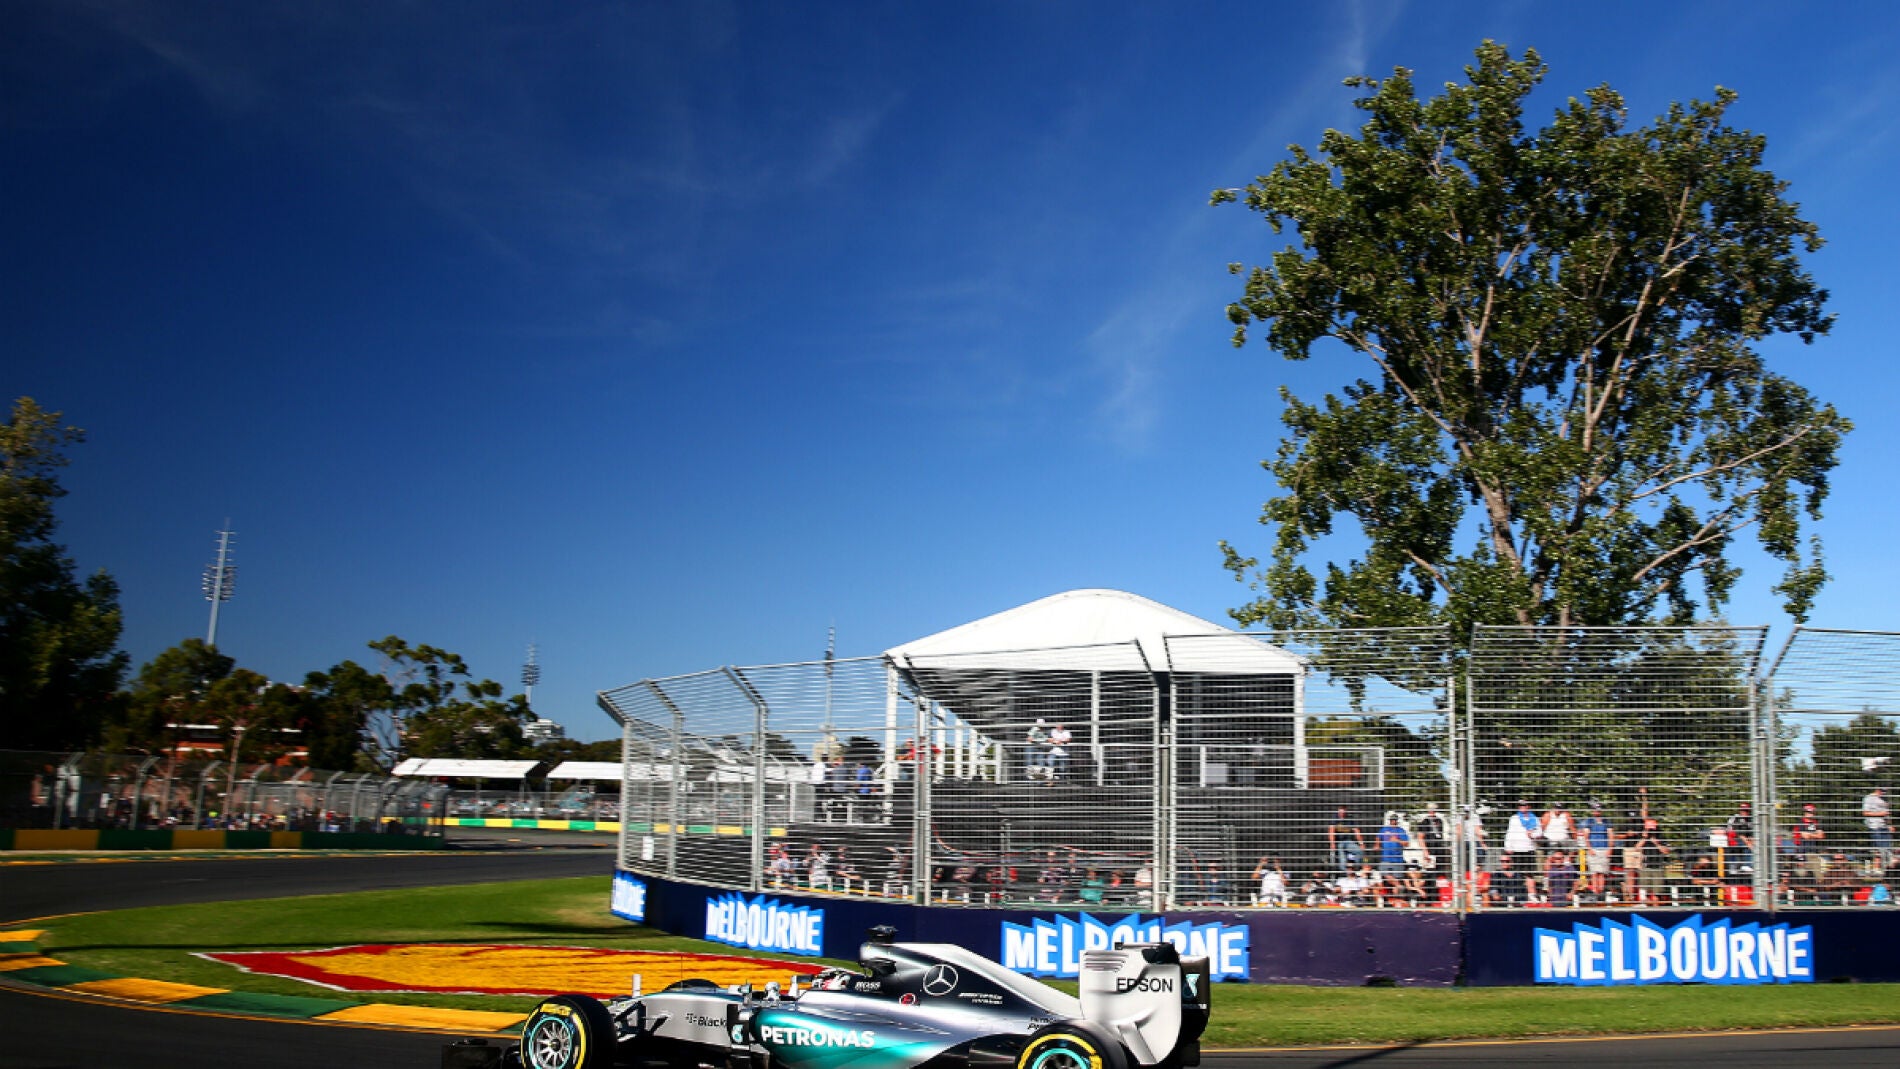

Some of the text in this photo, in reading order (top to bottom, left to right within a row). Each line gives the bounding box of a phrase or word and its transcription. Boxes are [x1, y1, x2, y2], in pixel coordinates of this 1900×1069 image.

[706, 899, 821, 951] MELBOURNE
[1539, 924, 1810, 980] MELBOURNE
[1116, 978, 1173, 993] EPSON
[761, 1025, 876, 1048] PETRONAS
